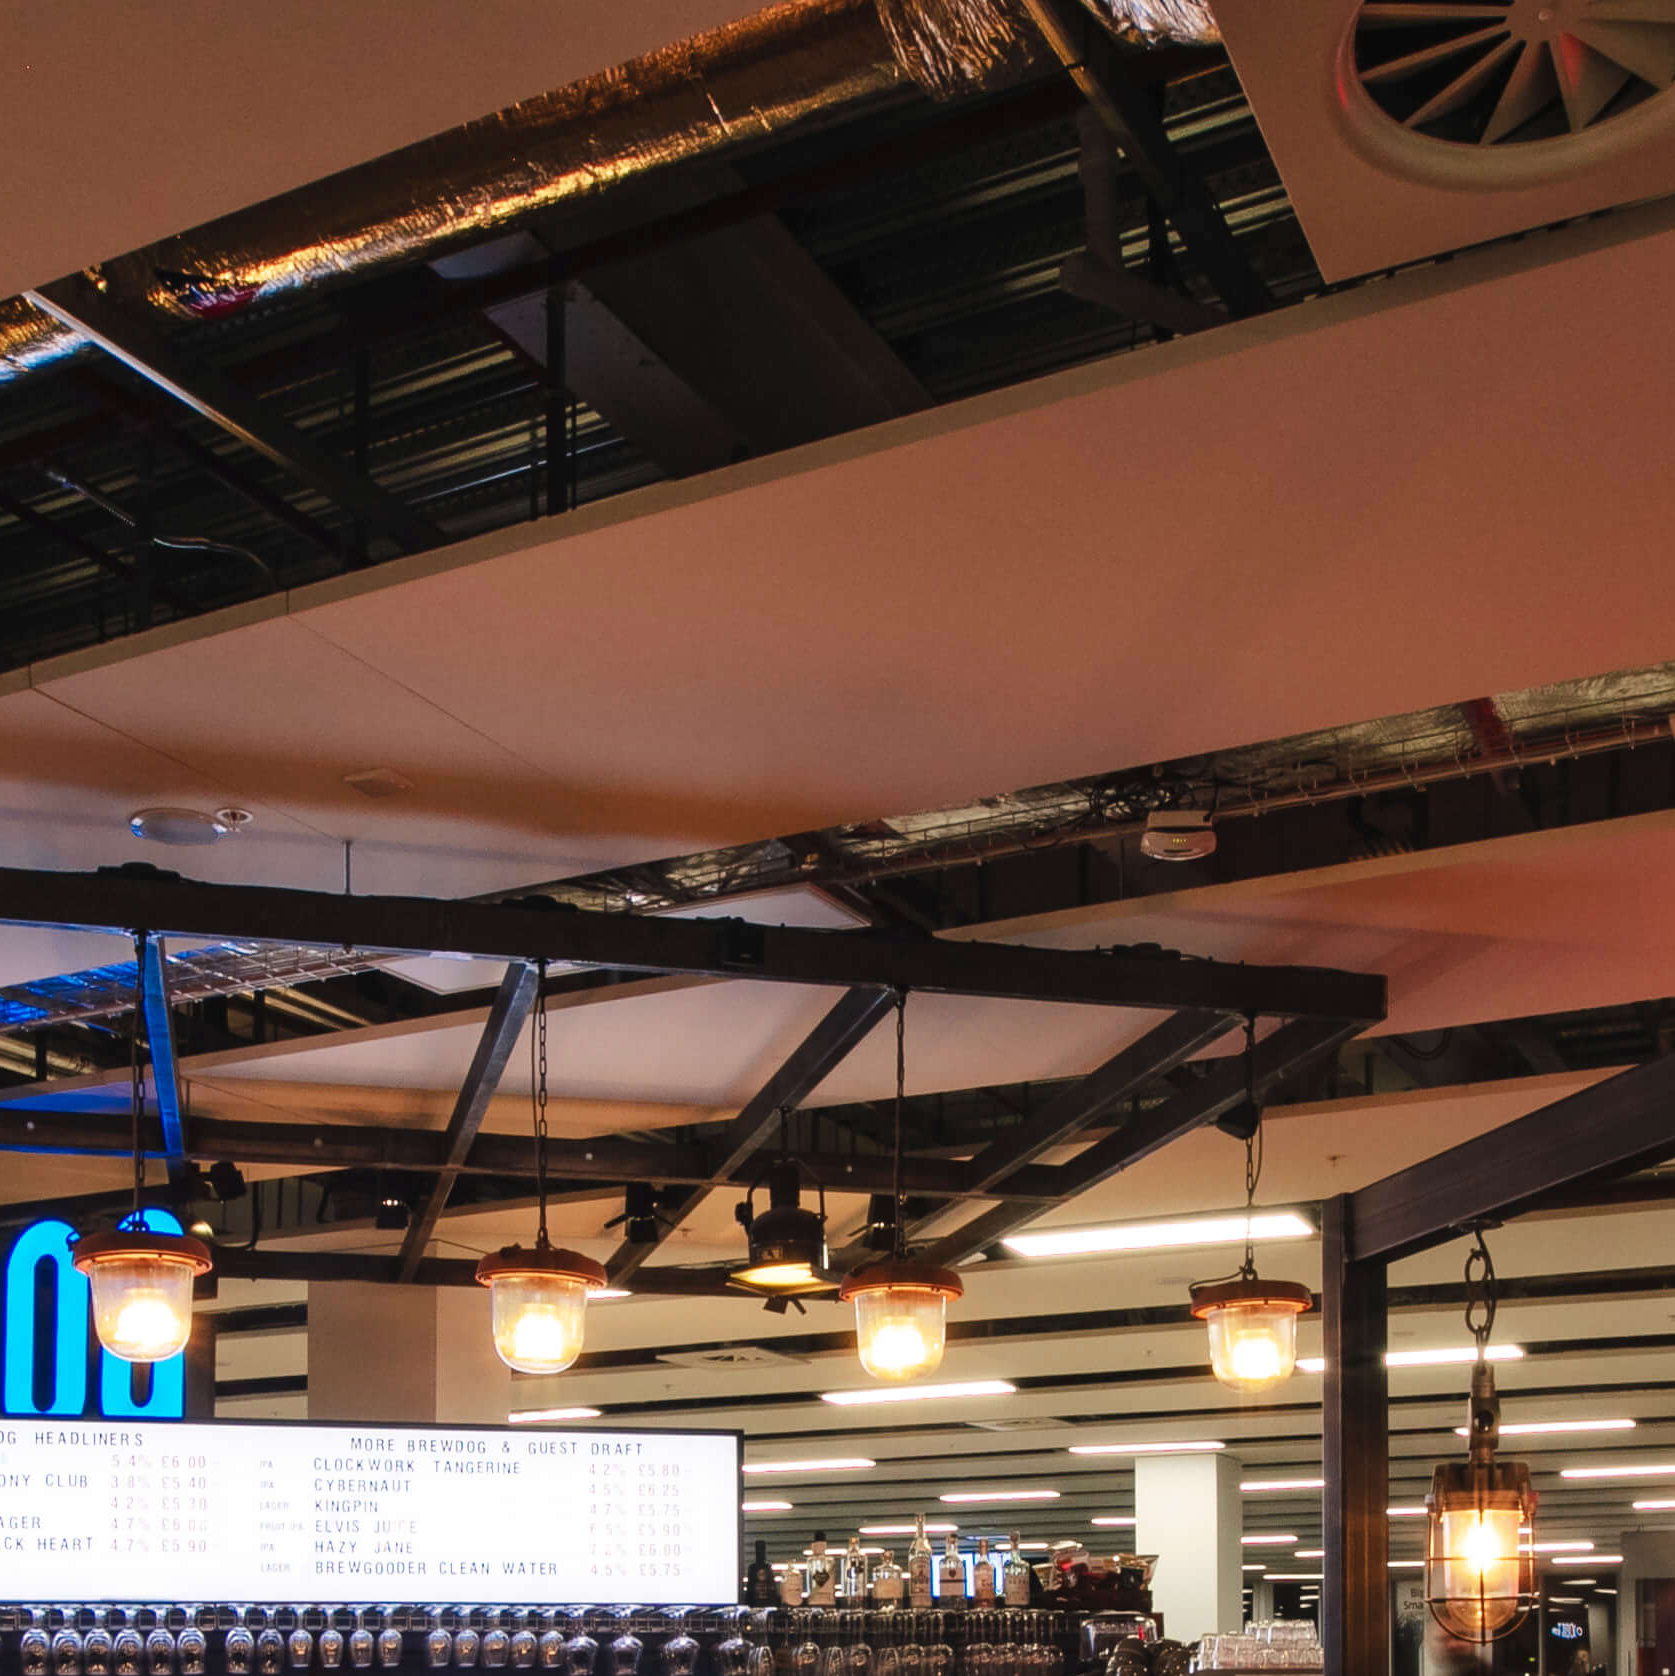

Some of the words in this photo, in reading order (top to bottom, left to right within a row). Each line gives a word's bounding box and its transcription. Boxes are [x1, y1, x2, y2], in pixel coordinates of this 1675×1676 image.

[35, 1431, 145, 1448] HEADLINERS
[350, 1437, 396, 1453] MORE
[407, 1439, 486, 1455] BREWDOG
[501, 1441, 511, 1454] &
[527, 1441, 578, 1456] GUEST
[590, 1442, 645, 1457] DRAFT
[313, 1456, 416, 1473] CLOCKWORK
[433, 1459, 521, 1475] TANGERINE
[44, 1473, 89, 1489] CLUB
[313, 1478, 413, 1493] CYBERNAUT
[314, 1499, 379, 1514] KINGPIN
[315, 1519, 361, 1534] ELVIS
[37, 1536, 94, 1552] HEART
[314, 1540, 357, 1554] HAZY
[373, 1540, 414, 1554] JANE
[315, 1560, 427, 1576] BREWGOODER
[439, 1561, 491, 1576] CLEAN
[502, 1561, 557, 1576] WATER
